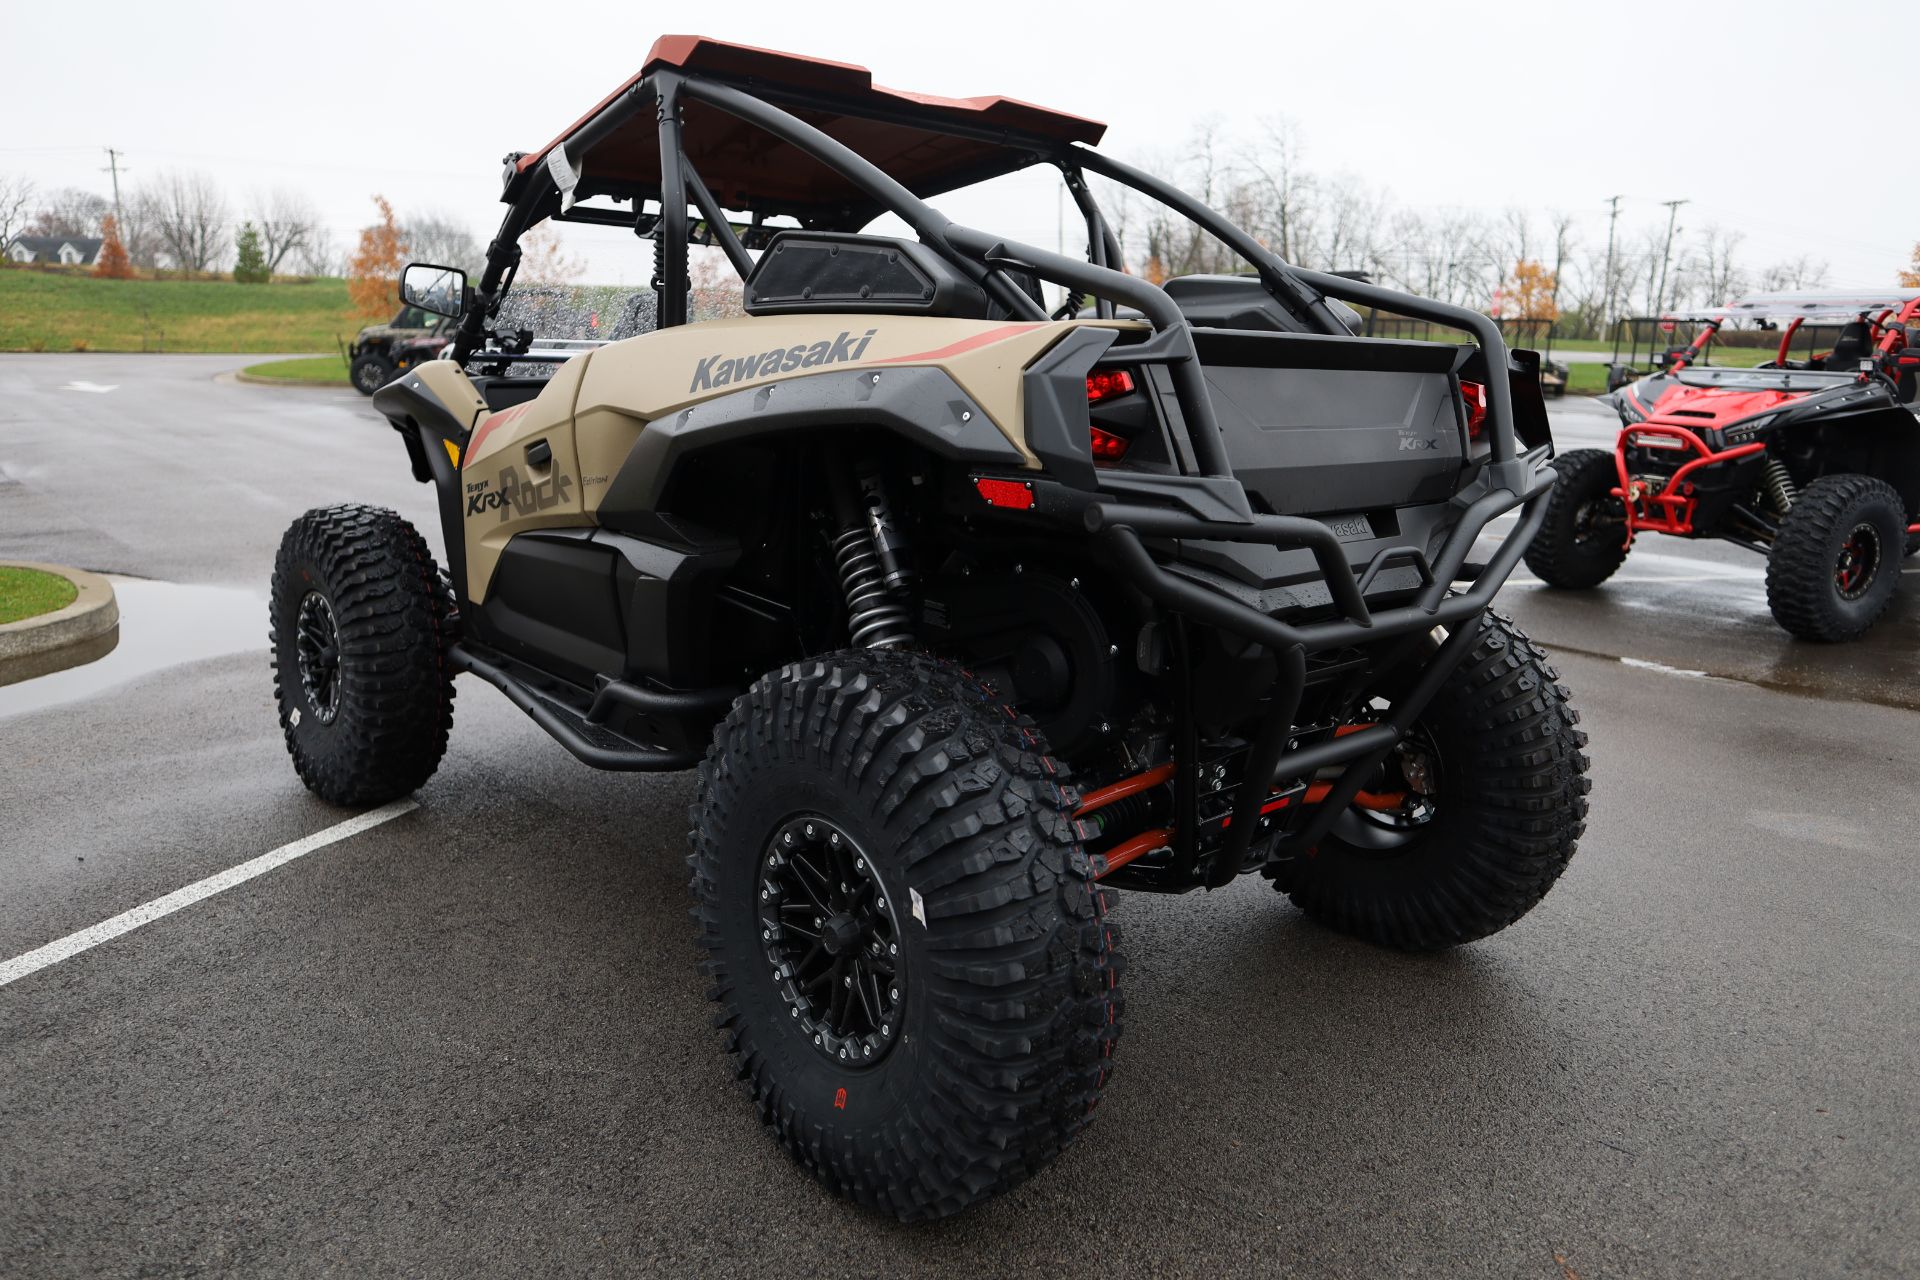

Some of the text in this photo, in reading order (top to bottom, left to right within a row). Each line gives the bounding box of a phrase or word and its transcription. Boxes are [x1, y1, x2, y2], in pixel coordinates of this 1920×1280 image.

[689, 329, 878, 393] Kawasaki
[467, 486, 512, 517] KRX
[1331, 516, 1369, 537] asaki
